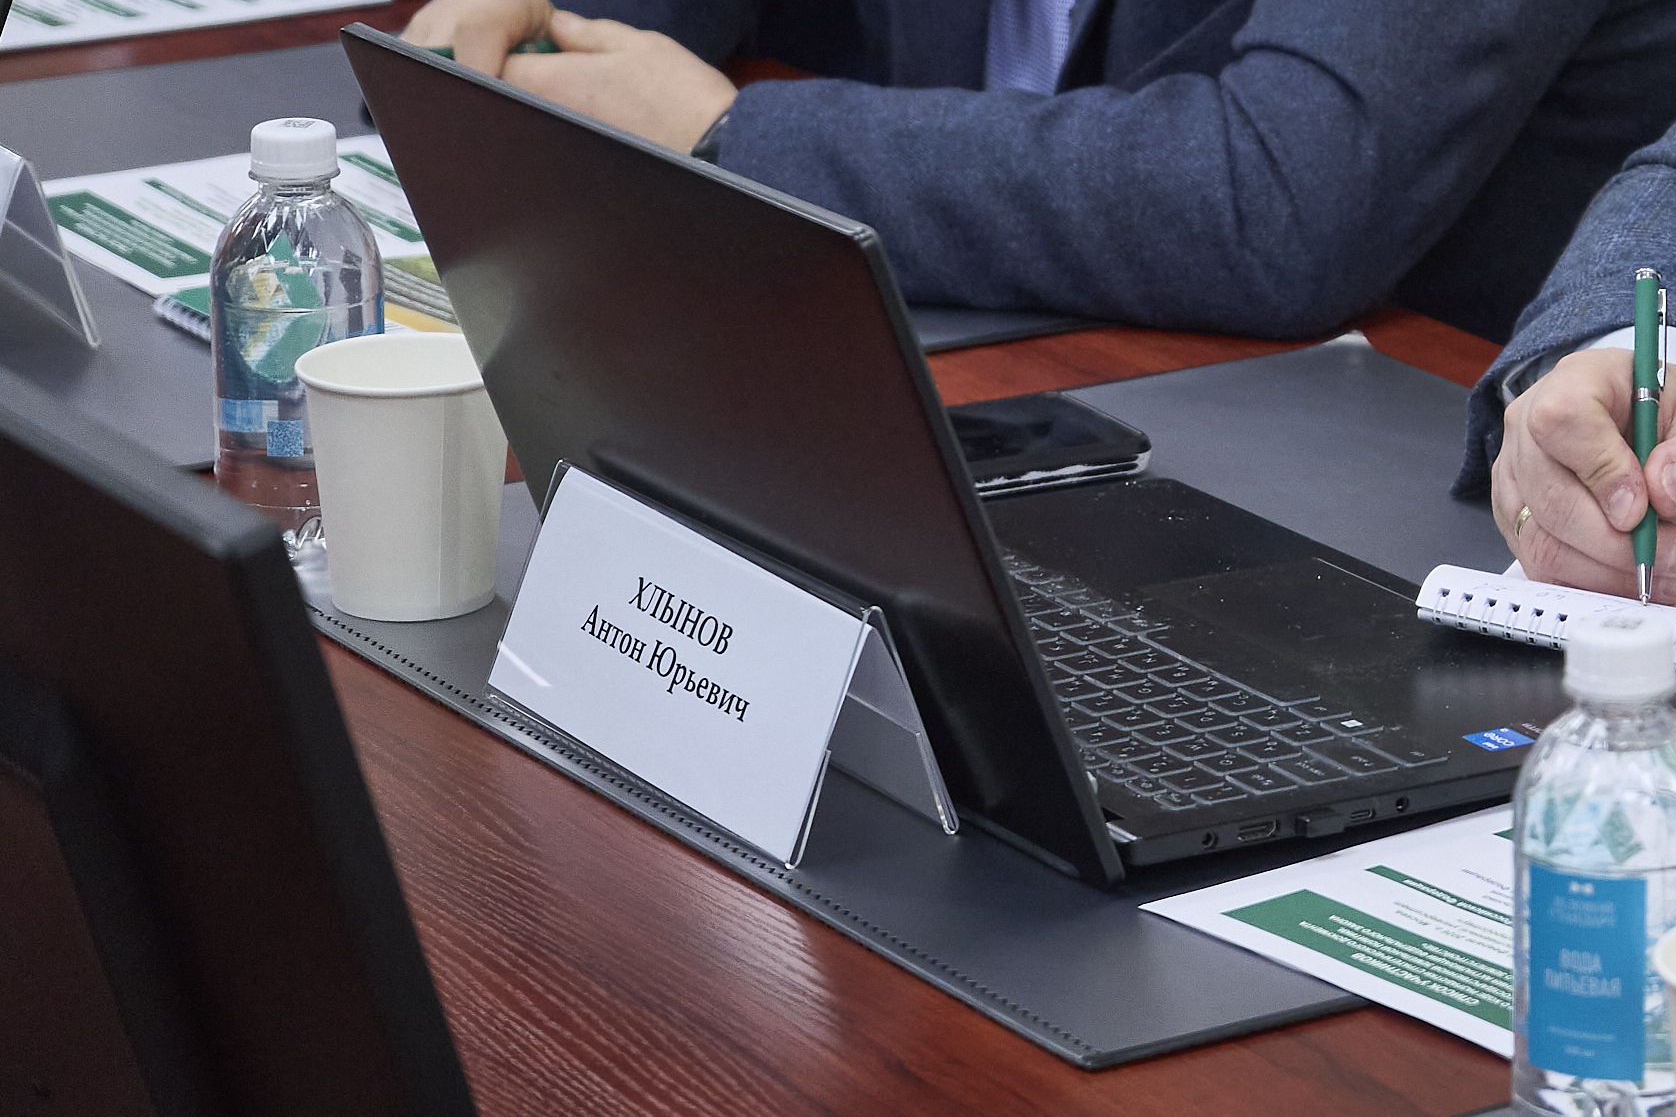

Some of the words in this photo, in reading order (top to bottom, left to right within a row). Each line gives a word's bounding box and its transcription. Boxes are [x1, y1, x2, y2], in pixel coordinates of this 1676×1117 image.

[580, 604, 646, 663] Антон
[646, 639, 750, 723] Юрьевич
[628, 576, 735, 656] ХЛЫНОВ
